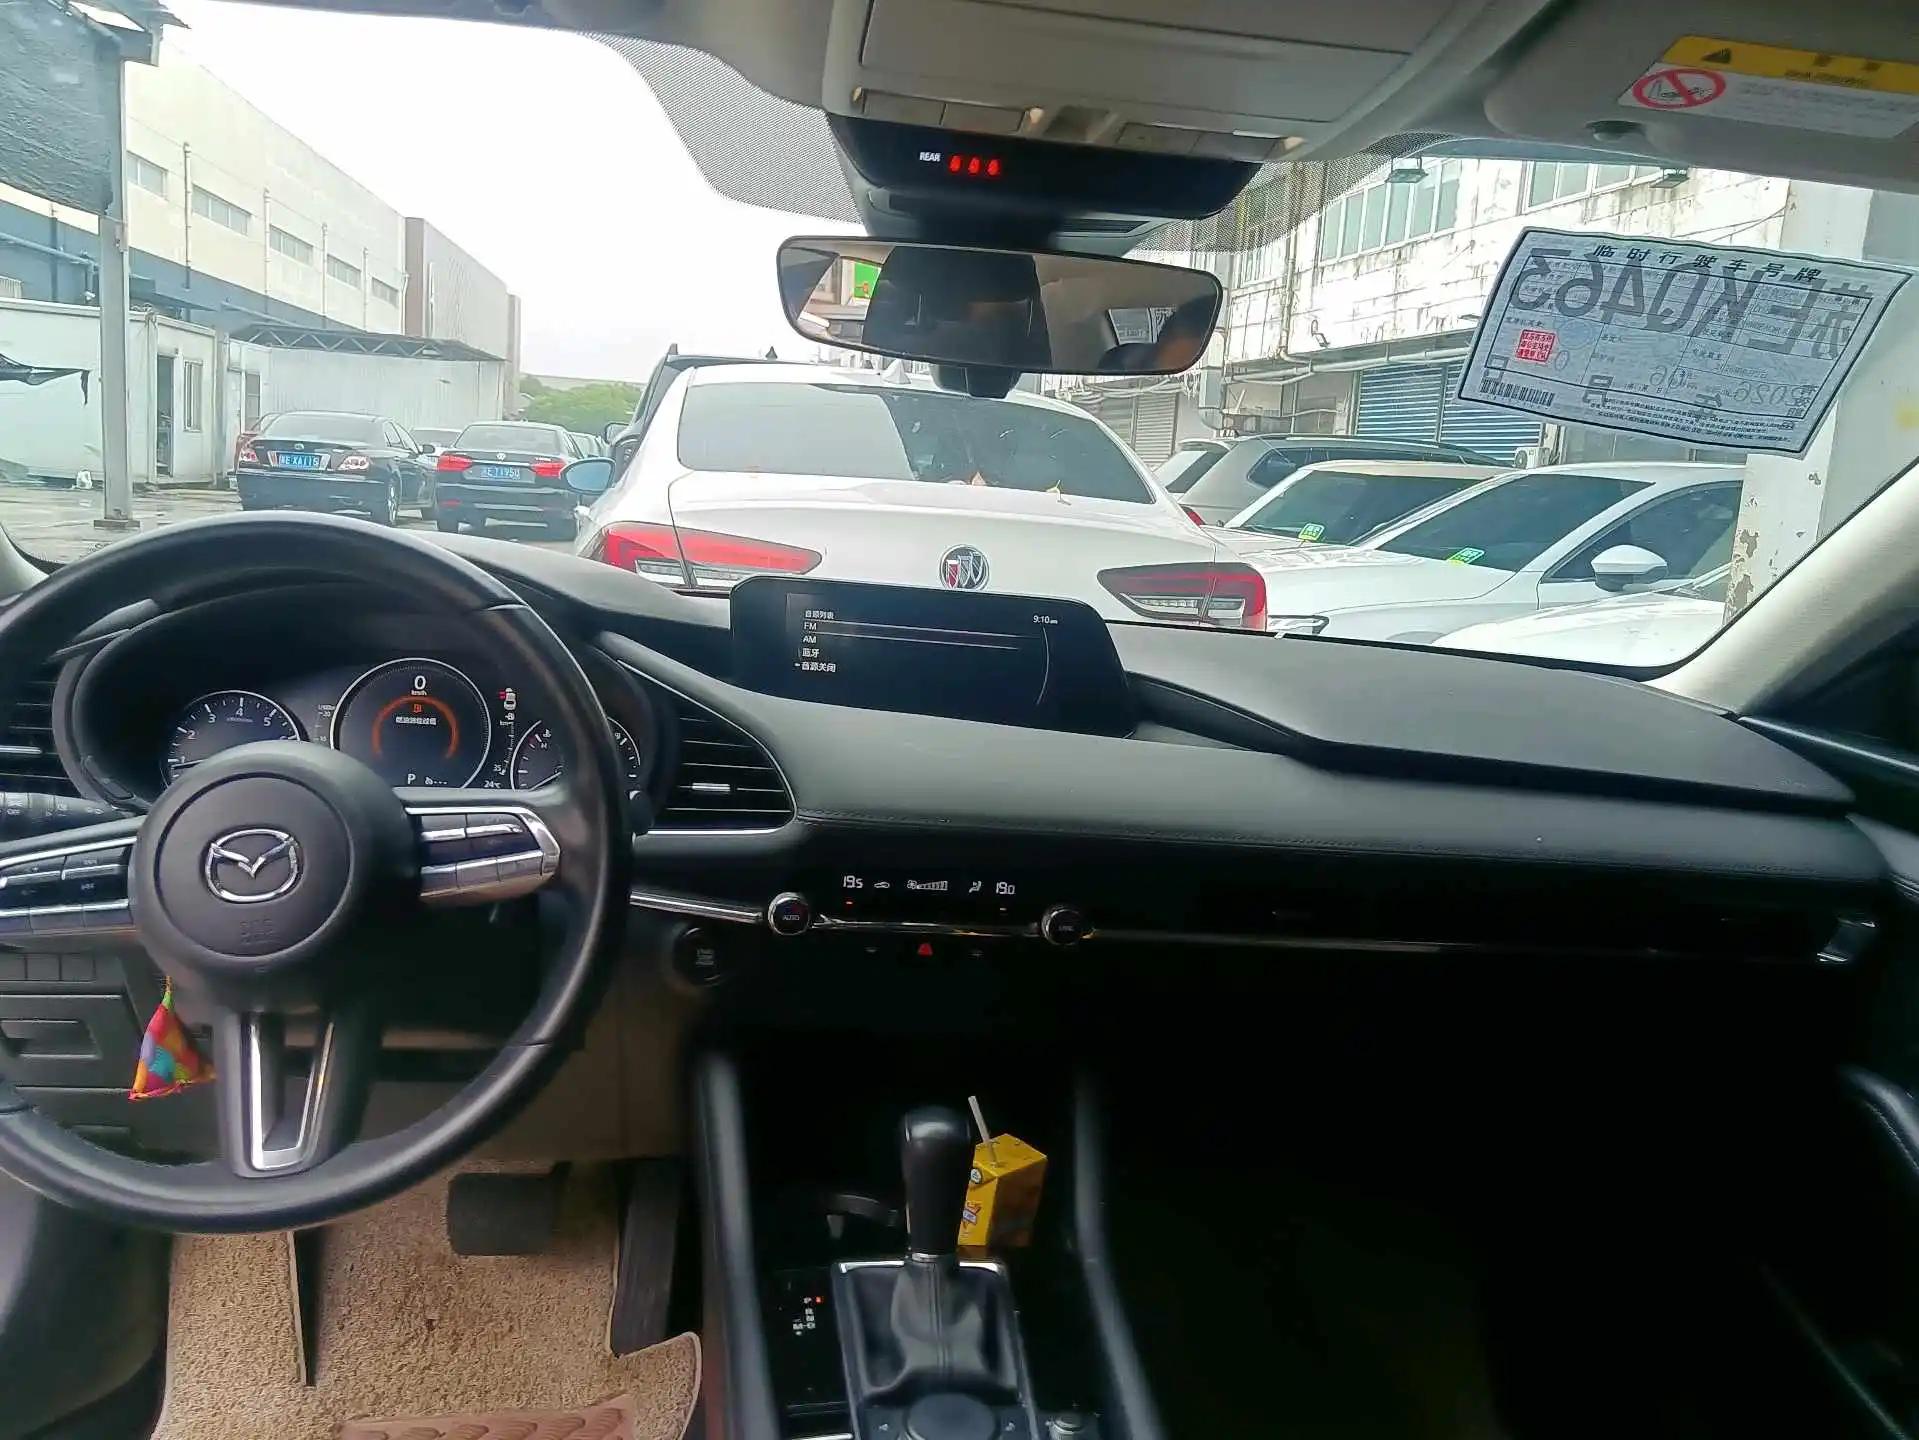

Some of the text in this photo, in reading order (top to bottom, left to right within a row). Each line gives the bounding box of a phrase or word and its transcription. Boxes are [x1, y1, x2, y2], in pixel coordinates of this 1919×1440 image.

[920, 151, 941, 162] REAR
[1593, 244, 1822, 282] 临时行驶车号牌
[804, 621, 817, 631] FM
[803, 635, 817, 644] AM
[414, 675, 427, 690] 0
[235, 707, 244, 717] 4
[208, 713, 217, 724] 3
[263, 716, 272, 727] 5
[187, 729, 196, 740] 2
[407, 773, 416, 785] P
